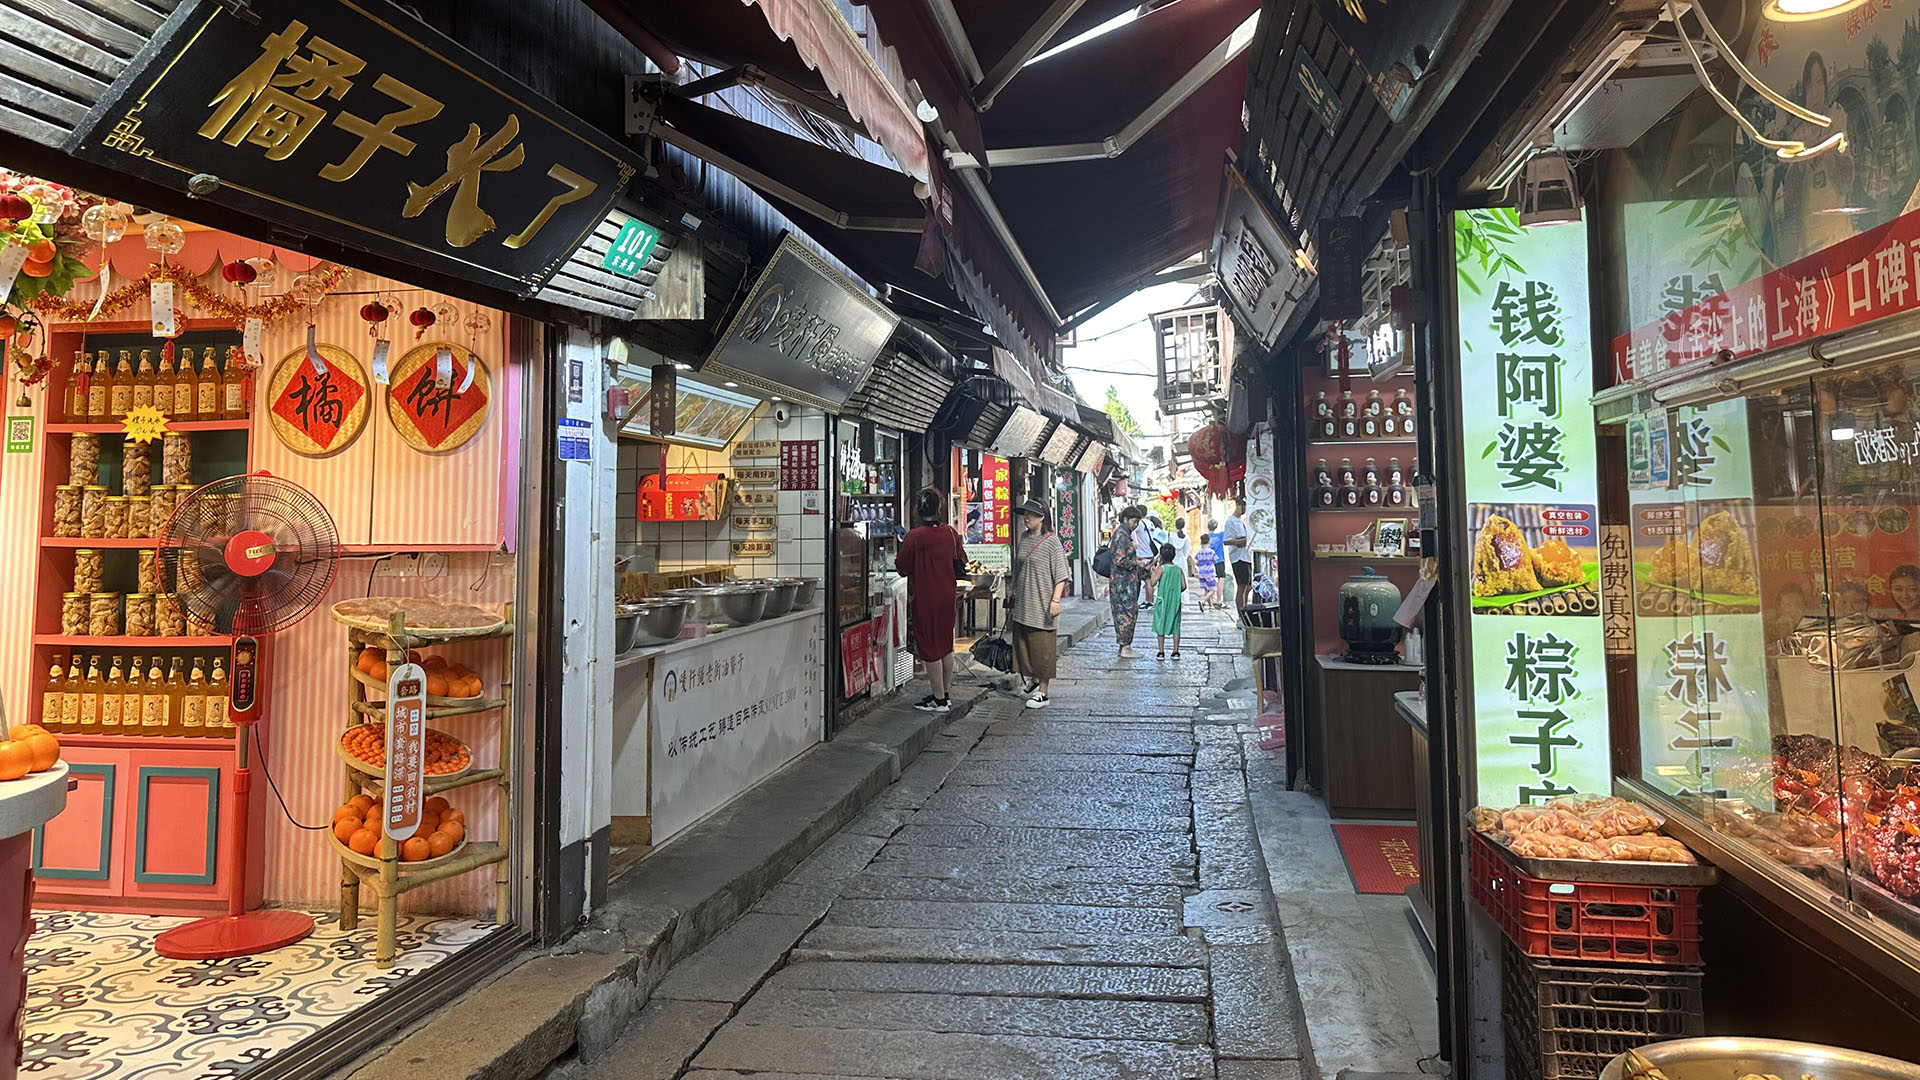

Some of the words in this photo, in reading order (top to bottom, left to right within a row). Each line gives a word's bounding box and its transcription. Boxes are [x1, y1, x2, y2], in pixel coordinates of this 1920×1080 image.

[198, 19, 598, 249] 橘子火了
[617, 227, 653, 259] 101
[1548, 511, 1582, 520] 真空包装
[1549, 527, 1583, 536] 新鲜选材
[1602, 532, 1633, 652] 免费真空
